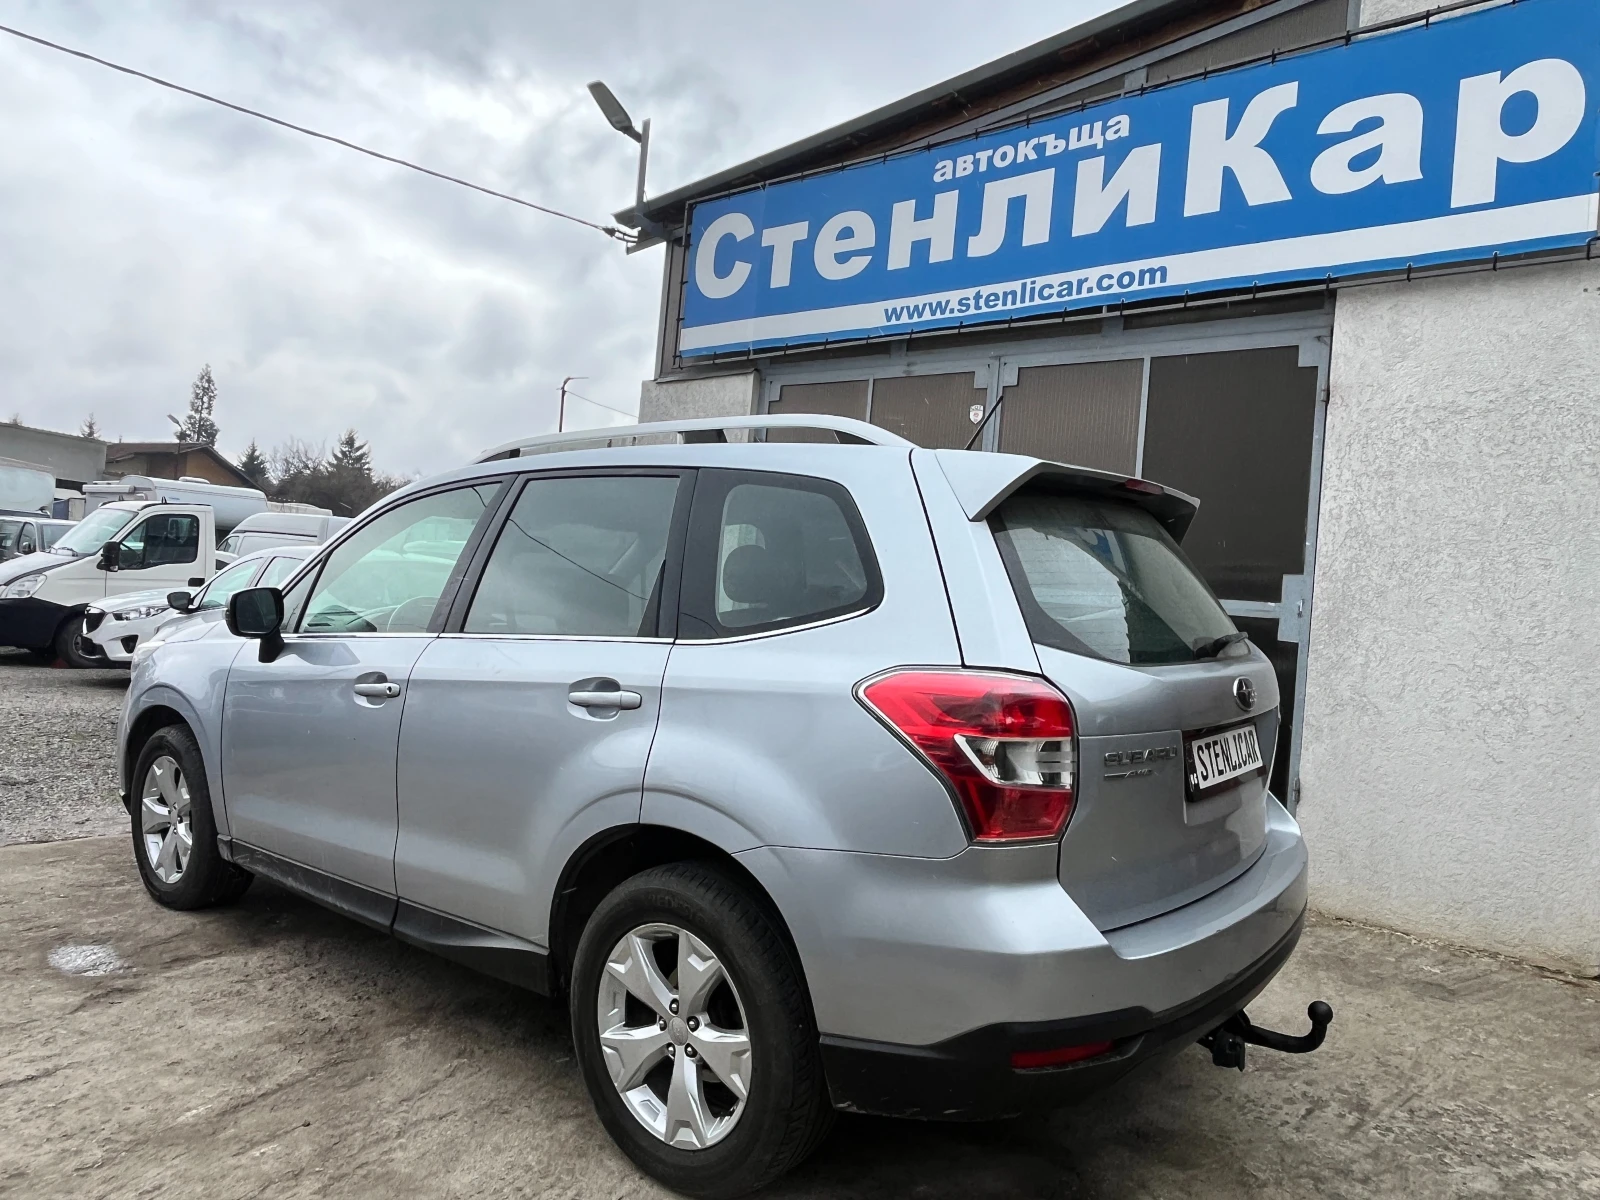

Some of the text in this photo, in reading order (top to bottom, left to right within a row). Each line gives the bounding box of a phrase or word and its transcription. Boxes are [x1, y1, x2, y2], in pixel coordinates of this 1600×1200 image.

[933, 114, 1130, 183] автокъща
[884, 265, 1168, 322] www.stenlicar.com
[1196, 730, 1260, 782] STENLICAR
